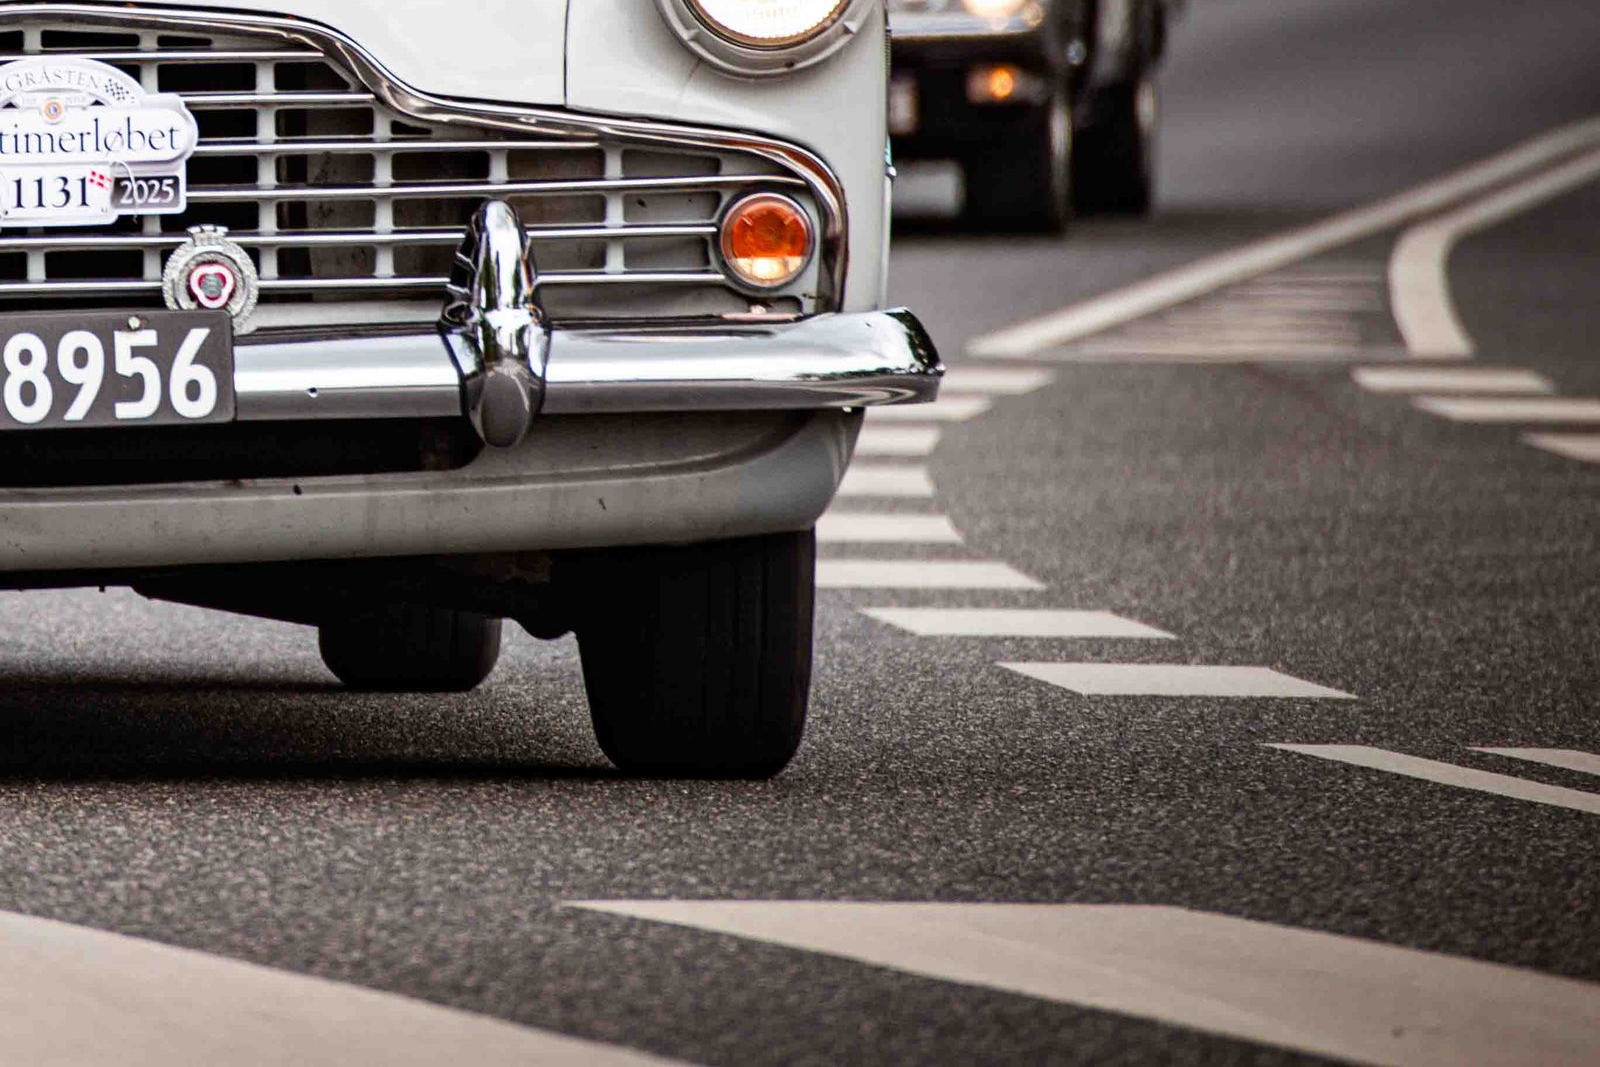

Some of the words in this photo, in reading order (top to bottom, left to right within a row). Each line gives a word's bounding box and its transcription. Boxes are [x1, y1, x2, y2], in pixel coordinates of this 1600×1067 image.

[11, 176, 91, 209] 1131
[119, 179, 176, 205] 2025
[2, 327, 218, 424] 8956
